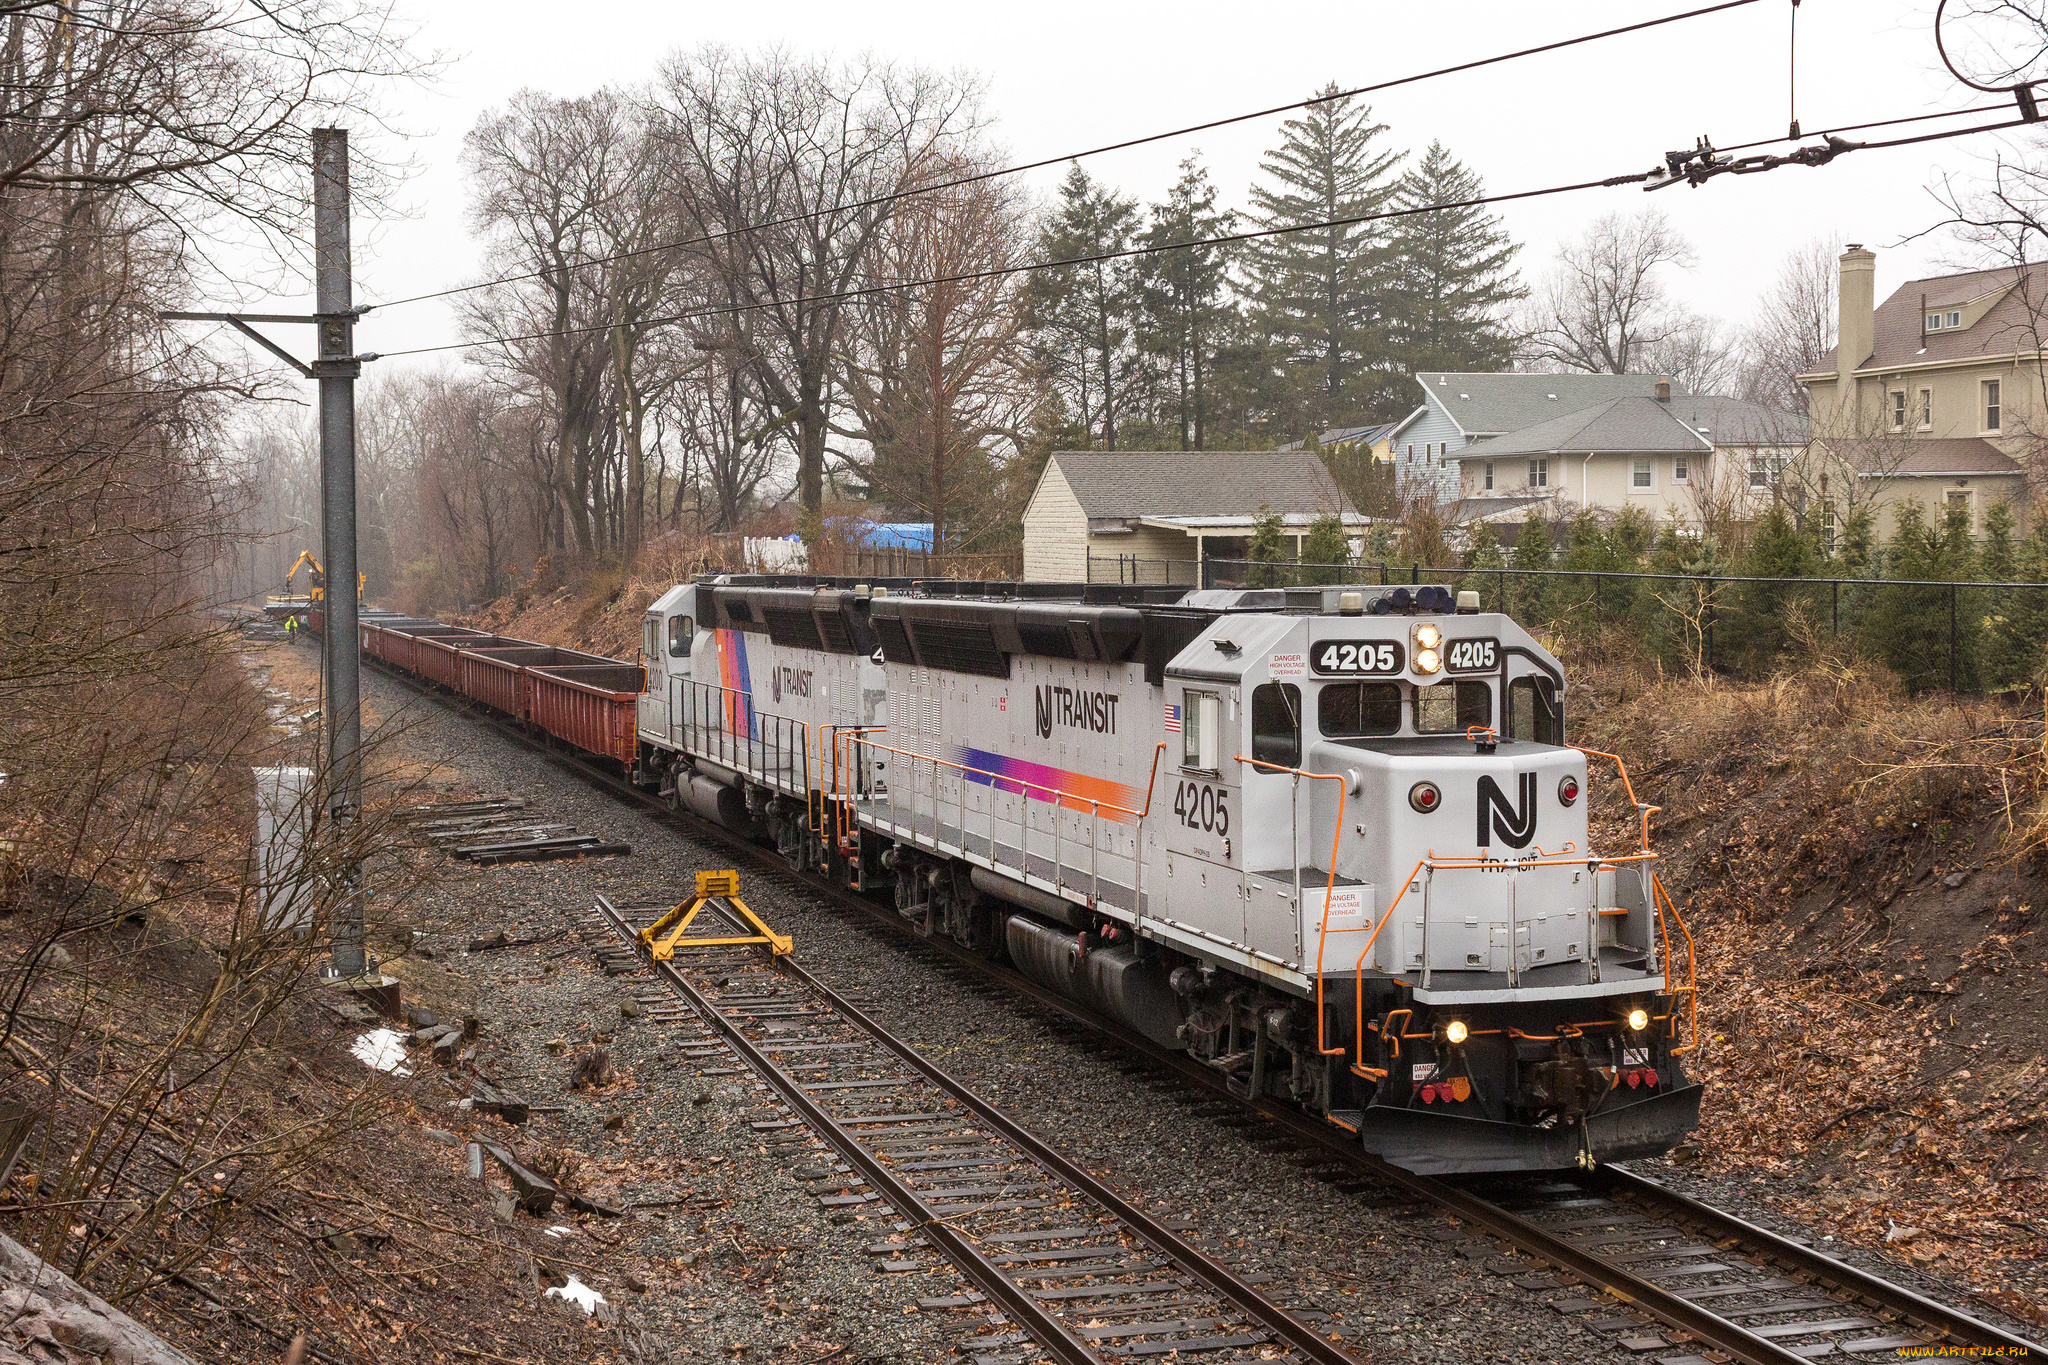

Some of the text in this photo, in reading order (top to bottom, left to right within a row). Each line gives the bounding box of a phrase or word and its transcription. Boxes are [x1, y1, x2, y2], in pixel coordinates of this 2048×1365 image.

[1320, 645, 1395, 671] 4205
[1450, 641, 1495, 668] 4205
[782, 666, 813, 699] TRANSIT
[1036, 684, 1119, 740] NJ TRANSIT
[1174, 780, 1229, 837] 4205
[1477, 771, 1538, 850] NJ
[1414, 1064, 1438, 1072] DANGE
